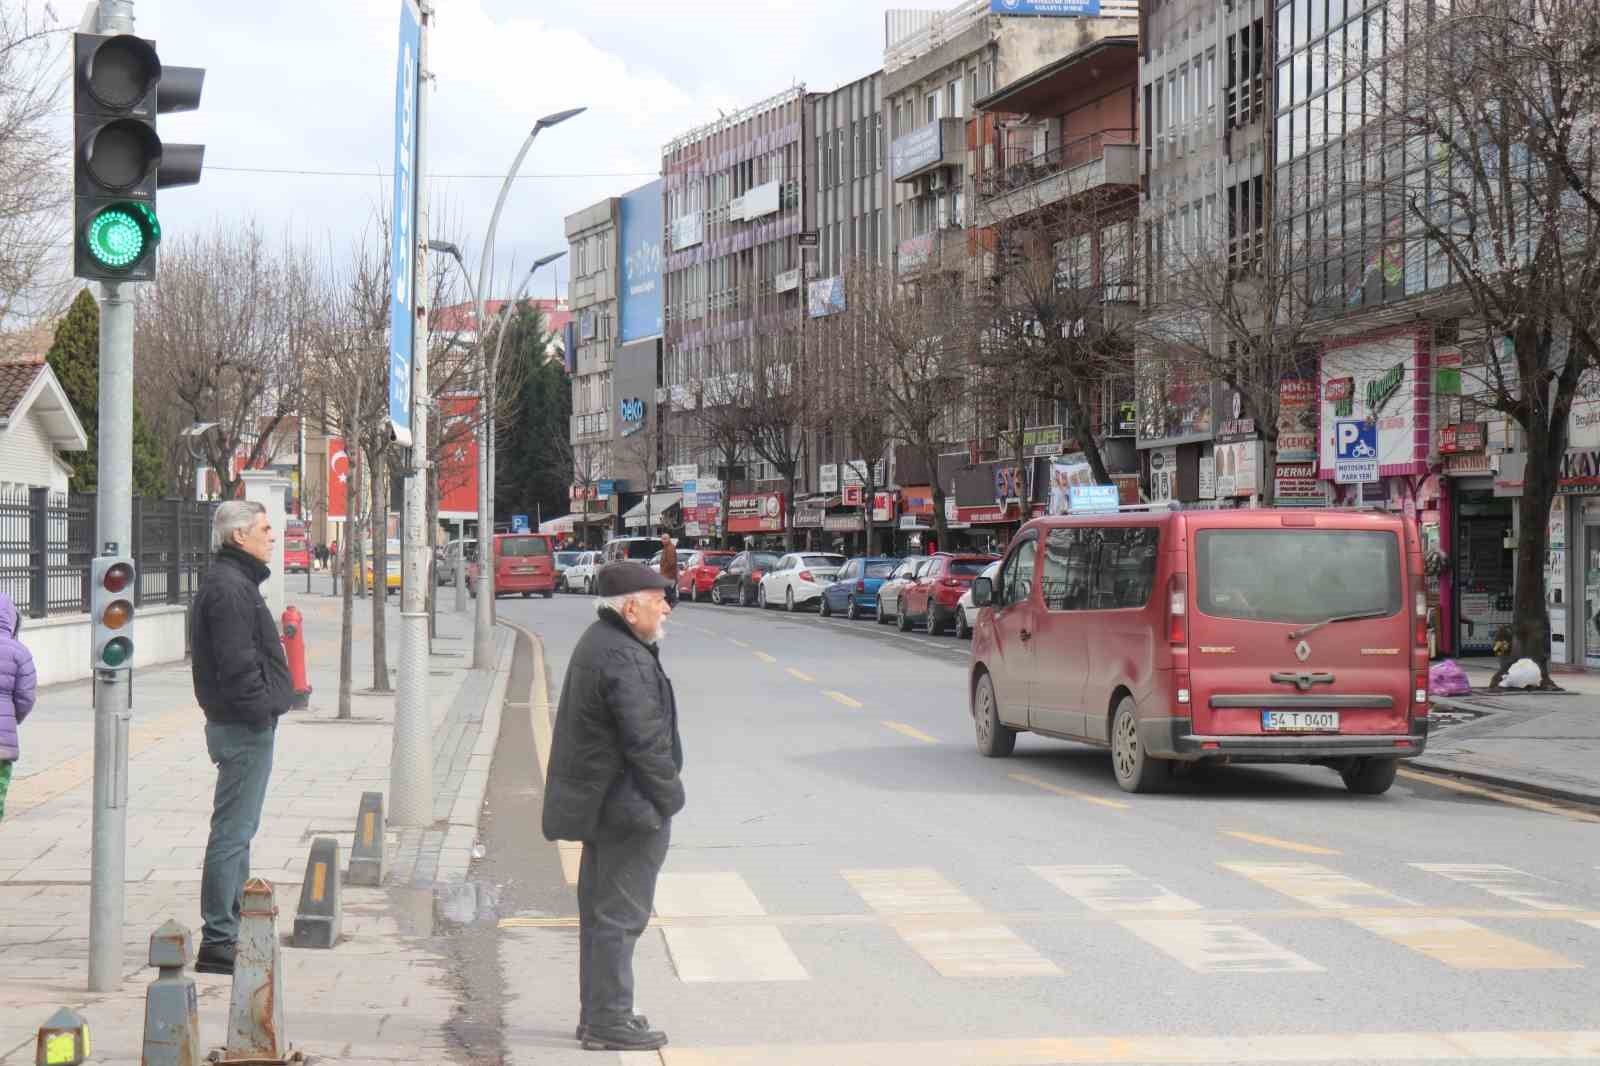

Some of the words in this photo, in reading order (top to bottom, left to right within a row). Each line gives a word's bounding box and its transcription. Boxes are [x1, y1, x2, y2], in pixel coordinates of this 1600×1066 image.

[618, 400, 643, 424] beko
[1338, 423, 1359, 455] P
[1276, 467, 1312, 477] DERMA
[1342, 473, 1358, 481] PARK
[1270, 713, 1286, 727] 54
[1289, 713, 1298, 726] T
[1304, 713, 1333, 727] 0401
